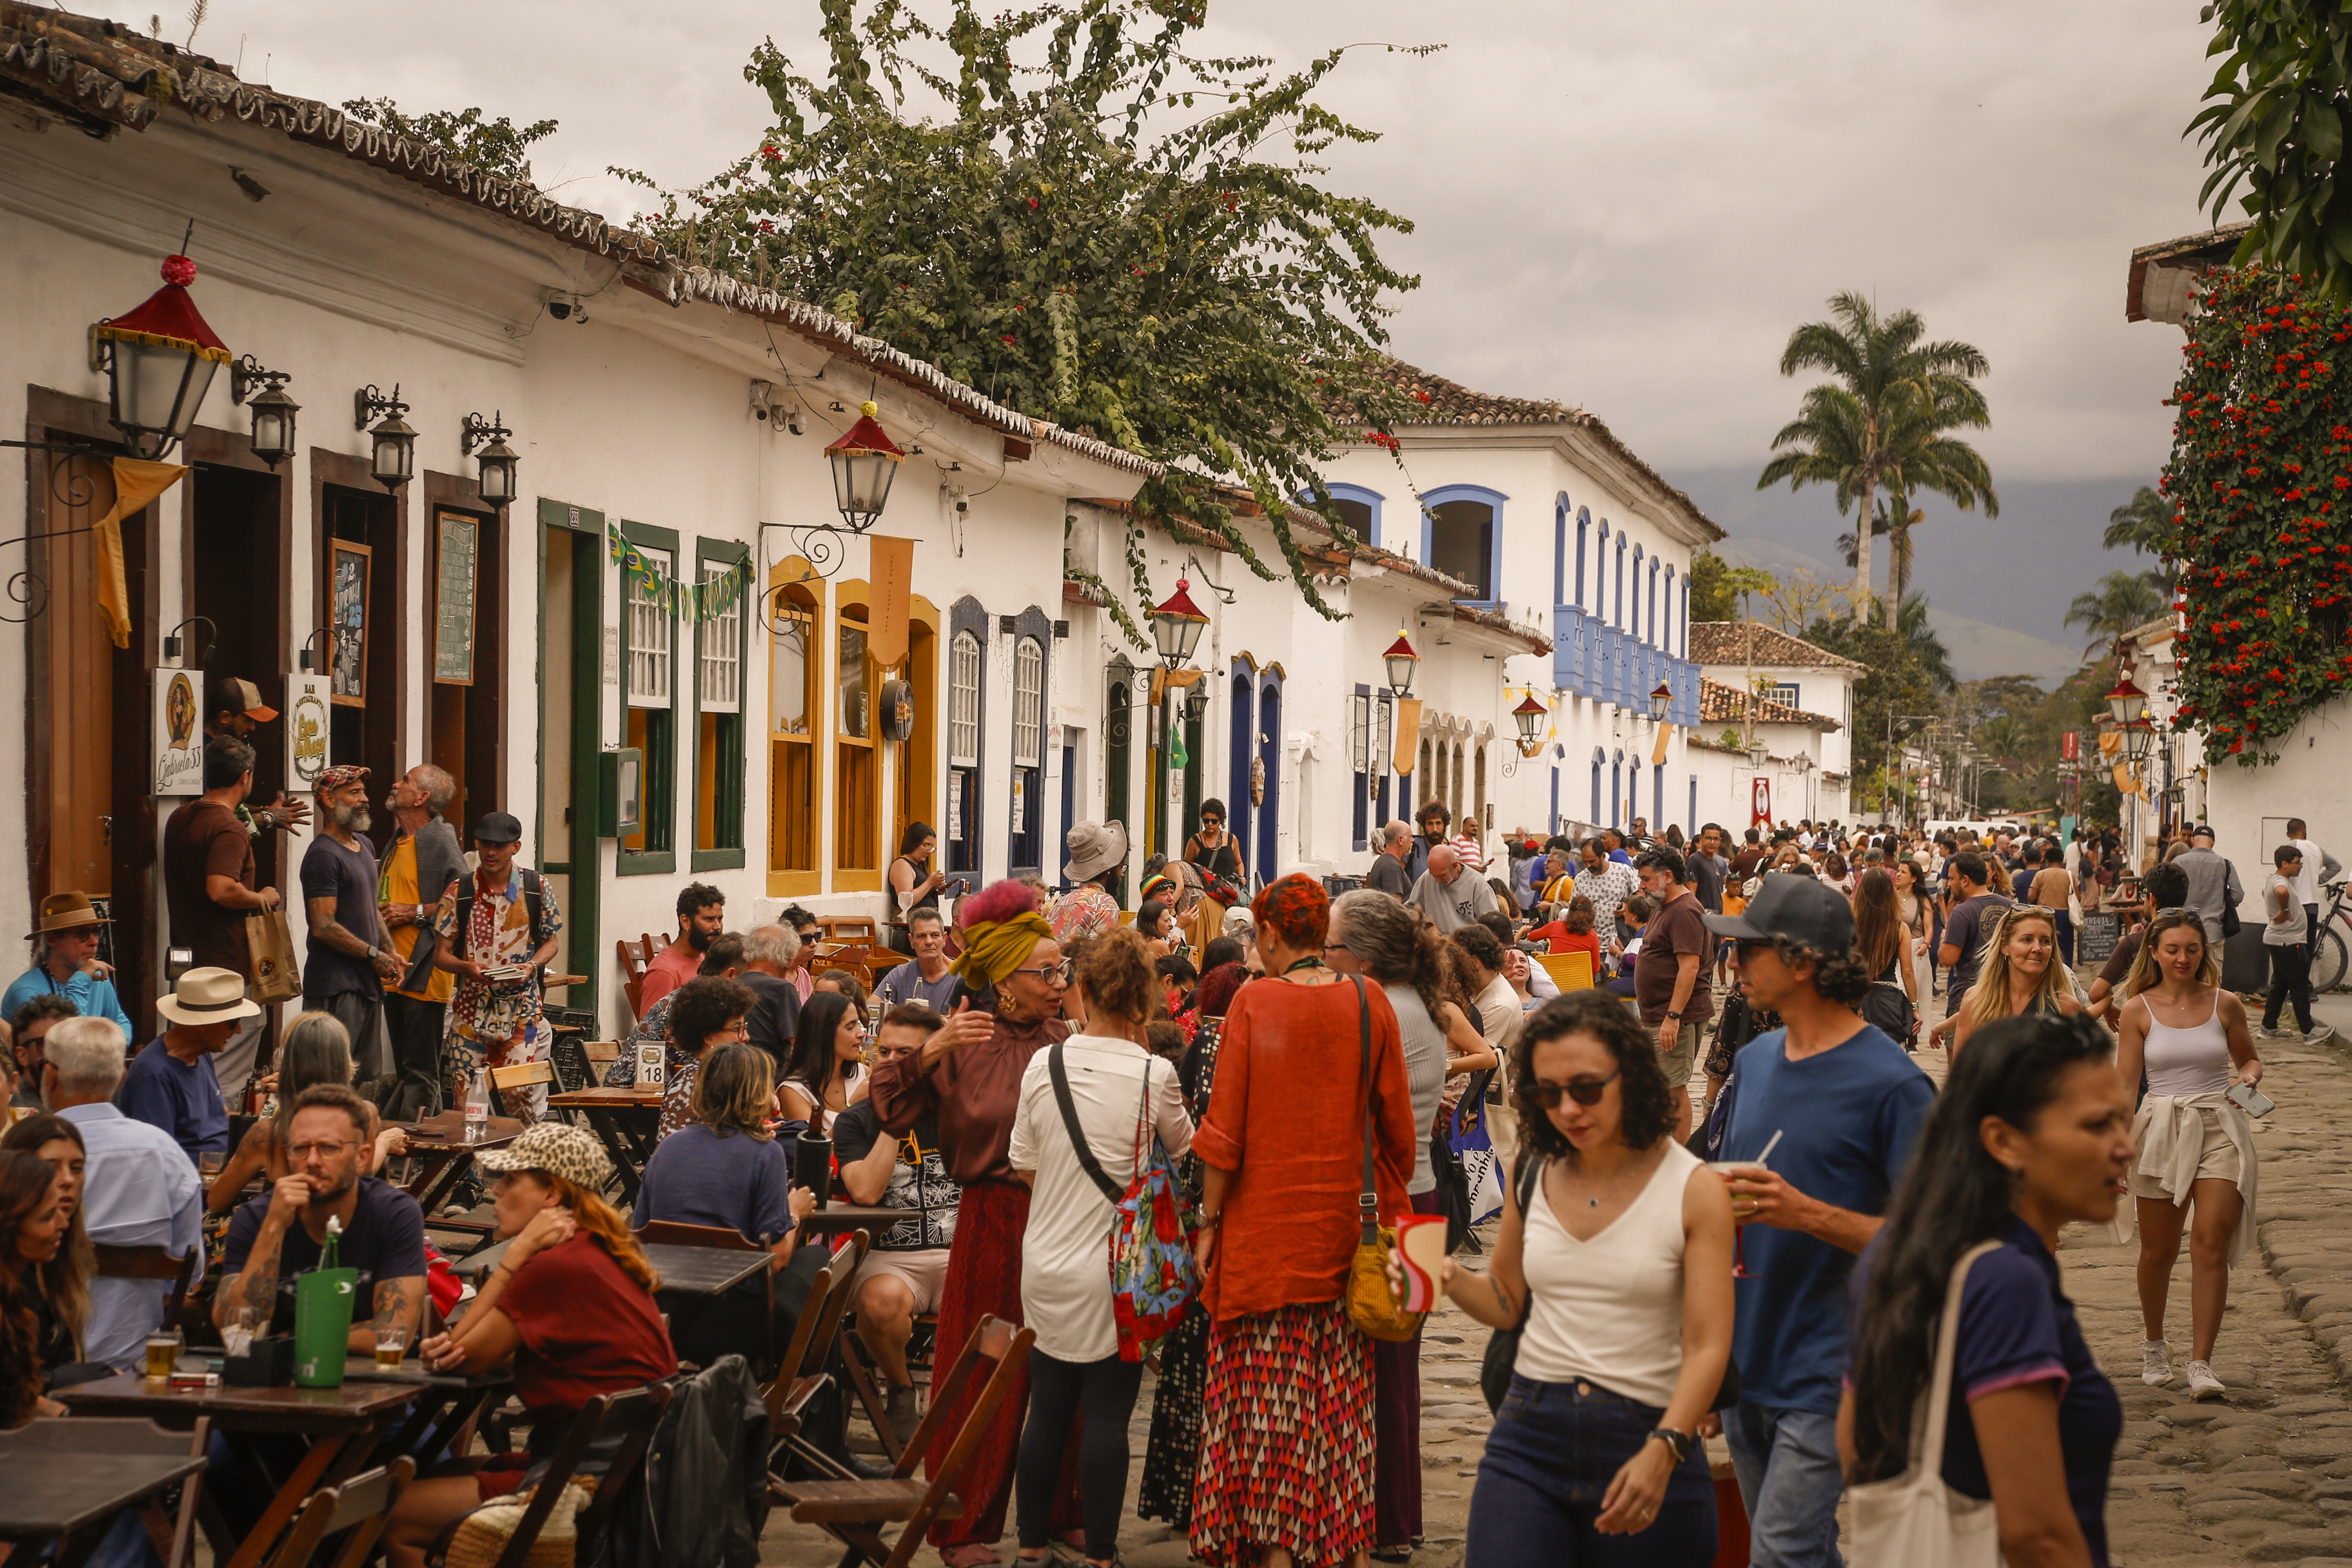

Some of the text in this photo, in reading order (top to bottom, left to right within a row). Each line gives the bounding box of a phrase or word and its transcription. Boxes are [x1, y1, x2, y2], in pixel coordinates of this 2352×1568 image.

[570, 510, 578, 524] 233
[304, 684, 315, 694] BAR
[645, 1067, 662, 1083] 18
